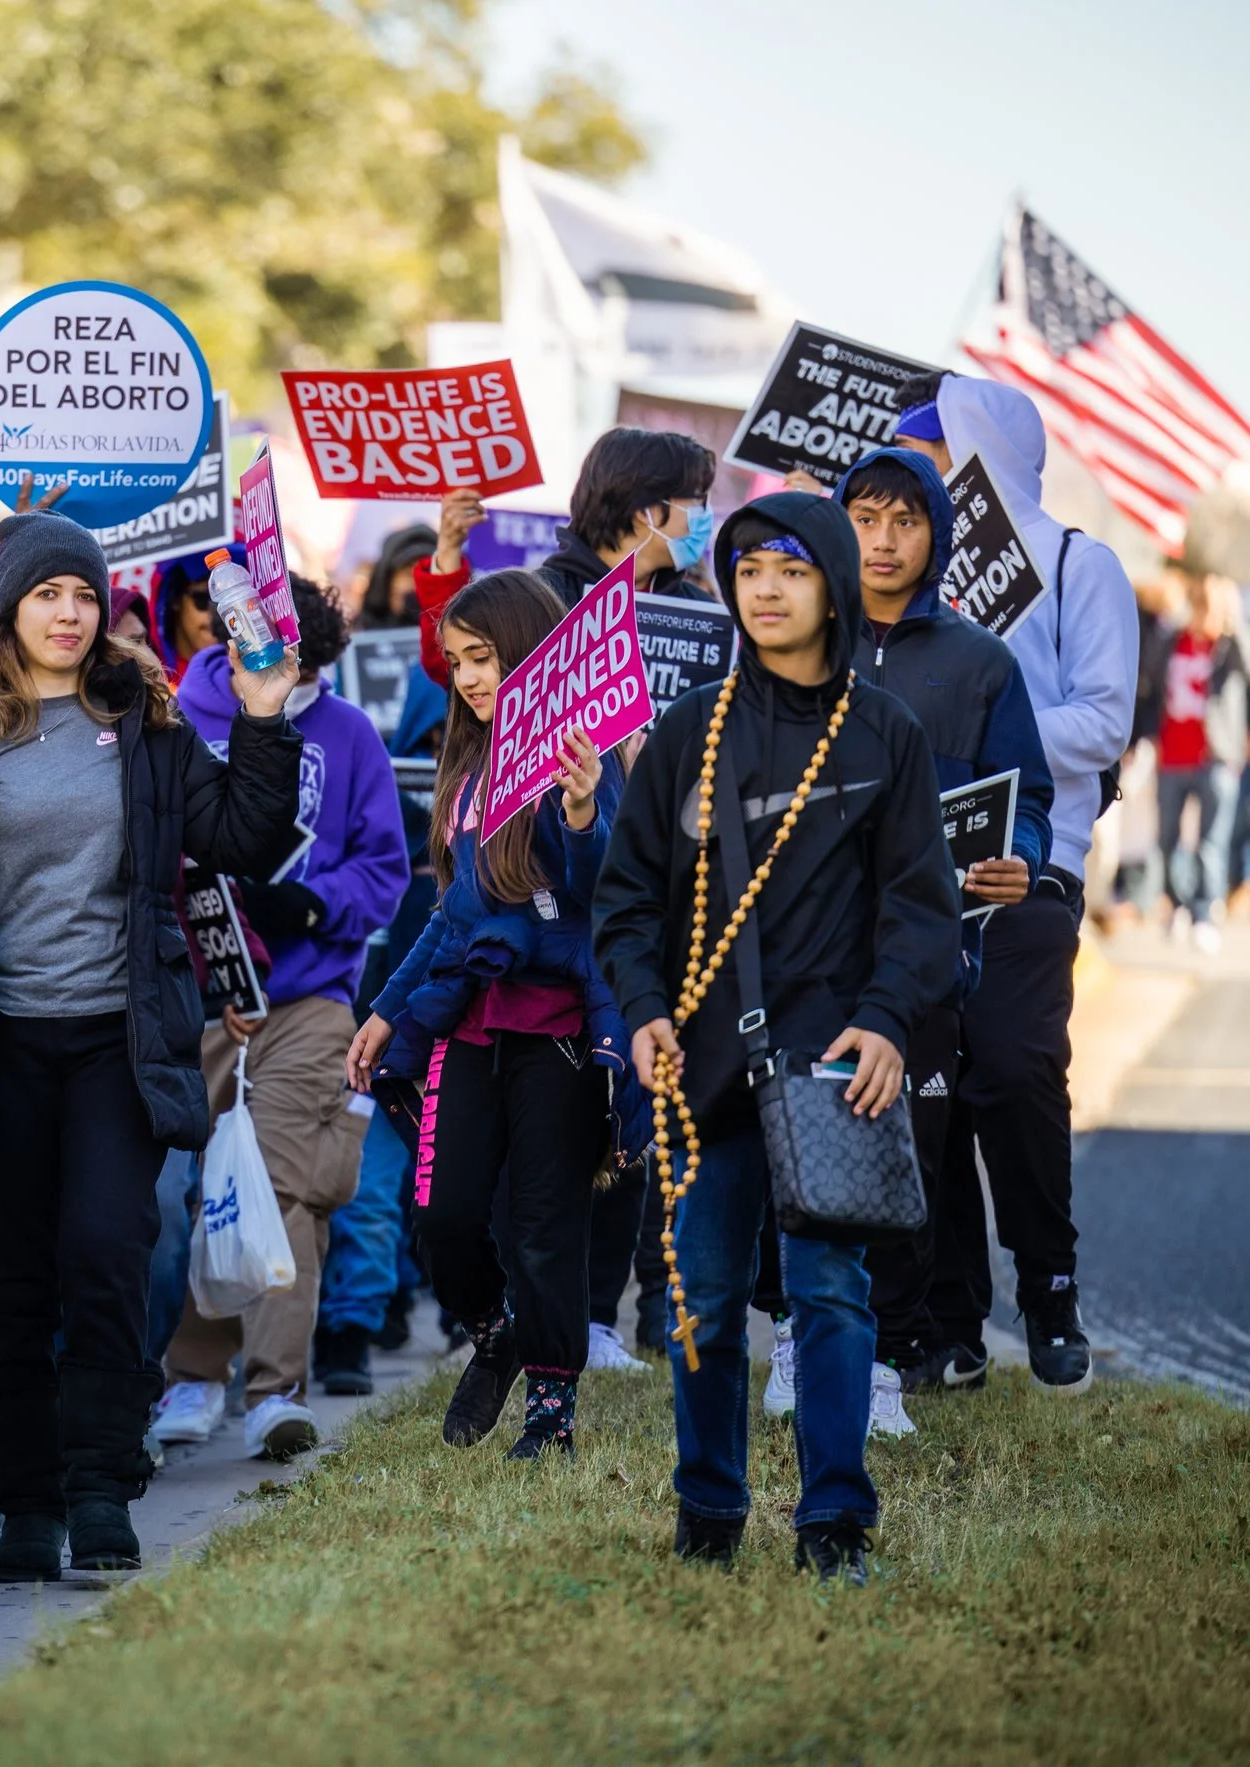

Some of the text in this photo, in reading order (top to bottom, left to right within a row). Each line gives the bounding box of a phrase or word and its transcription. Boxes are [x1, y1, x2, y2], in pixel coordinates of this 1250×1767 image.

[54, 316, 136, 341] REZA
[6, 349, 181, 377] POR EL FIN
[797, 358, 842, 389] THE
[57, 385, 190, 411] ABORTO
[295, 372, 507, 410] PRO-LIFE IS
[301, 399, 518, 442] EVIDENCE
[25, 429, 68, 451] DÍAS
[72, 434, 108, 452] POR
[311, 434, 527, 487] BASED
[241, 476, 275, 537] DEFUND
[969, 493, 989, 521] IS
[499, 580, 630, 739] DEFUND
[703, 643, 720, 666] IS
[496, 629, 632, 784] PLANNED
[490, 675, 639, 816] PARENTHOOD
[966, 811, 989, 832] IS
[919, 1086, 948, 1098] adidas
